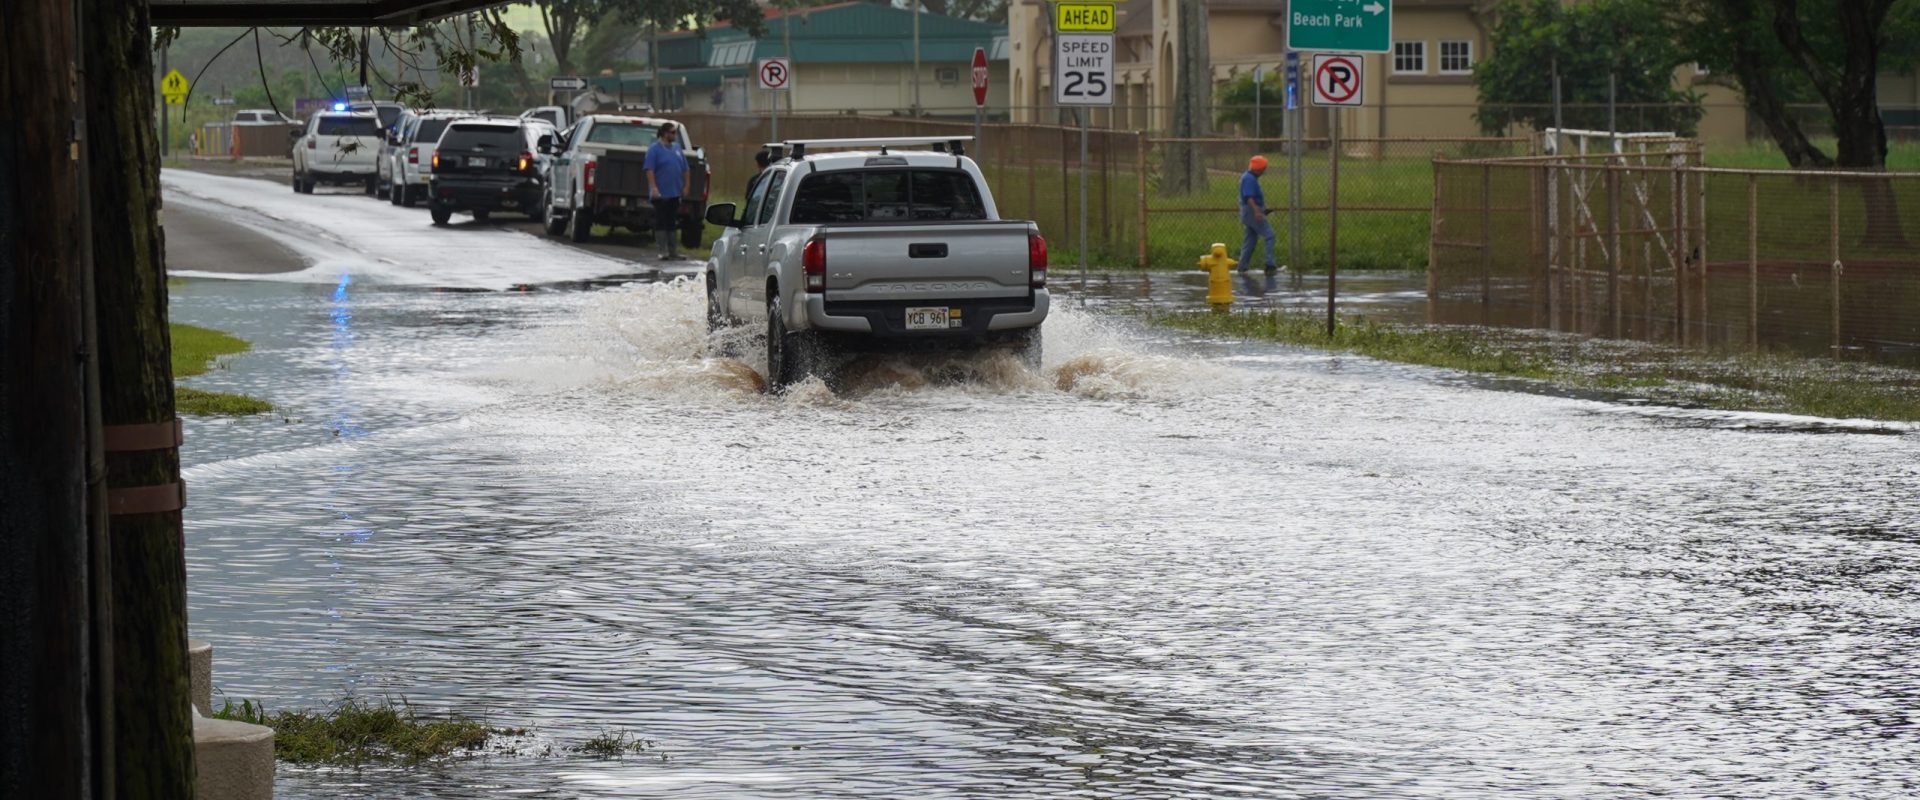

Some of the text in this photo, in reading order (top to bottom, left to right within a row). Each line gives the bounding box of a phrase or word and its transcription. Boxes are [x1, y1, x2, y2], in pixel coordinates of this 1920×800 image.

[1064, 10, 1109, 25] AHEAD
[1293, 12, 1363, 28] Beach Park
[1062, 42, 1109, 53] SPEED
[1067, 56, 1104, 67] LIMIT
[973, 66, 988, 88] STOP
[1063, 71, 1107, 97] 25
[870, 282, 988, 294] TACOMA
[907, 312, 925, 325] YCB
[930, 312, 946, 325] 961
